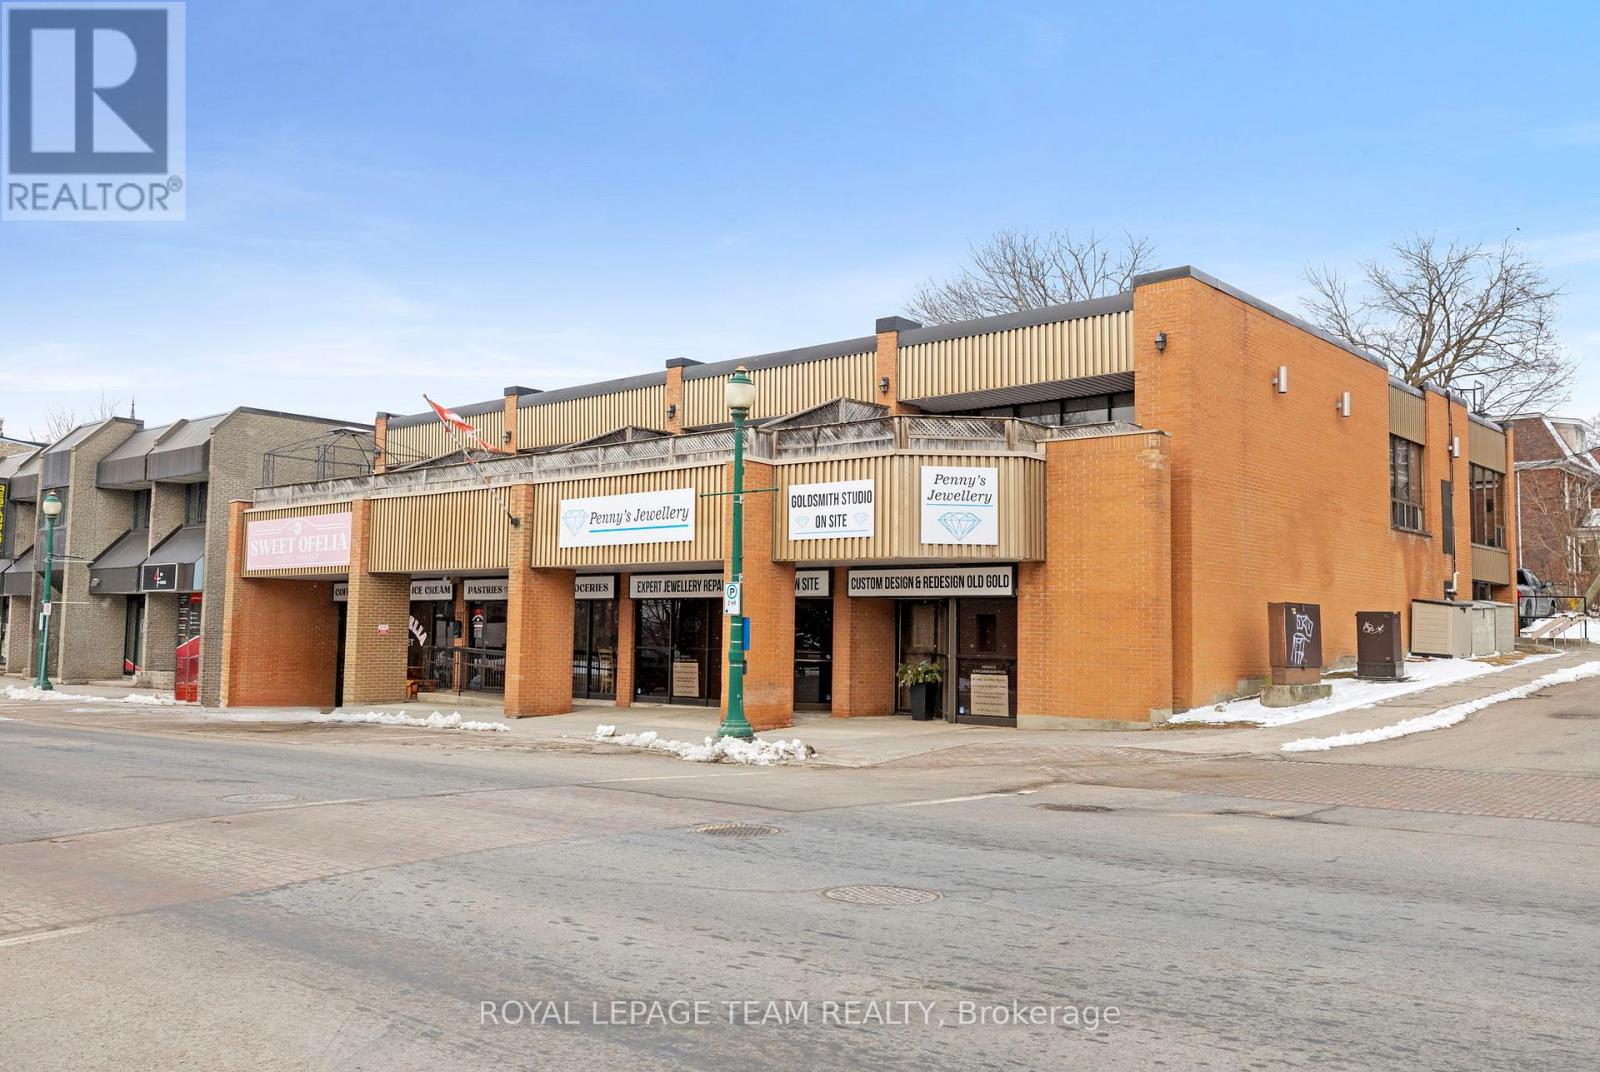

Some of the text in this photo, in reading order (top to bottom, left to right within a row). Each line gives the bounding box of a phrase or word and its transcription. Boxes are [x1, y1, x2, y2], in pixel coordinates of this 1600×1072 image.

[933, 473, 986, 487] Penny's
[791, 489, 873, 508] GOLDSMITH STUDIO
[927, 489, 993, 504] Jewellery
[589, 506, 689, 526] Penny's Jewellery
[815, 514, 848, 529] ON SITE
[250, 532, 347, 556] SWEET OFELIA
[411, 585, 451, 594] ICE CREAM
[468, 585, 503, 594] PASTRIES
[575, 582, 609, 592] OCERIES
[637, 578, 724, 593] EXPERT JEWELLERY REPAI
[802, 577, 820, 591] SITE
[851, 574, 1009, 590] CUSTOM DESIGN & REDESIGN OLD GOLD
[335, 588, 348, 596] COF
